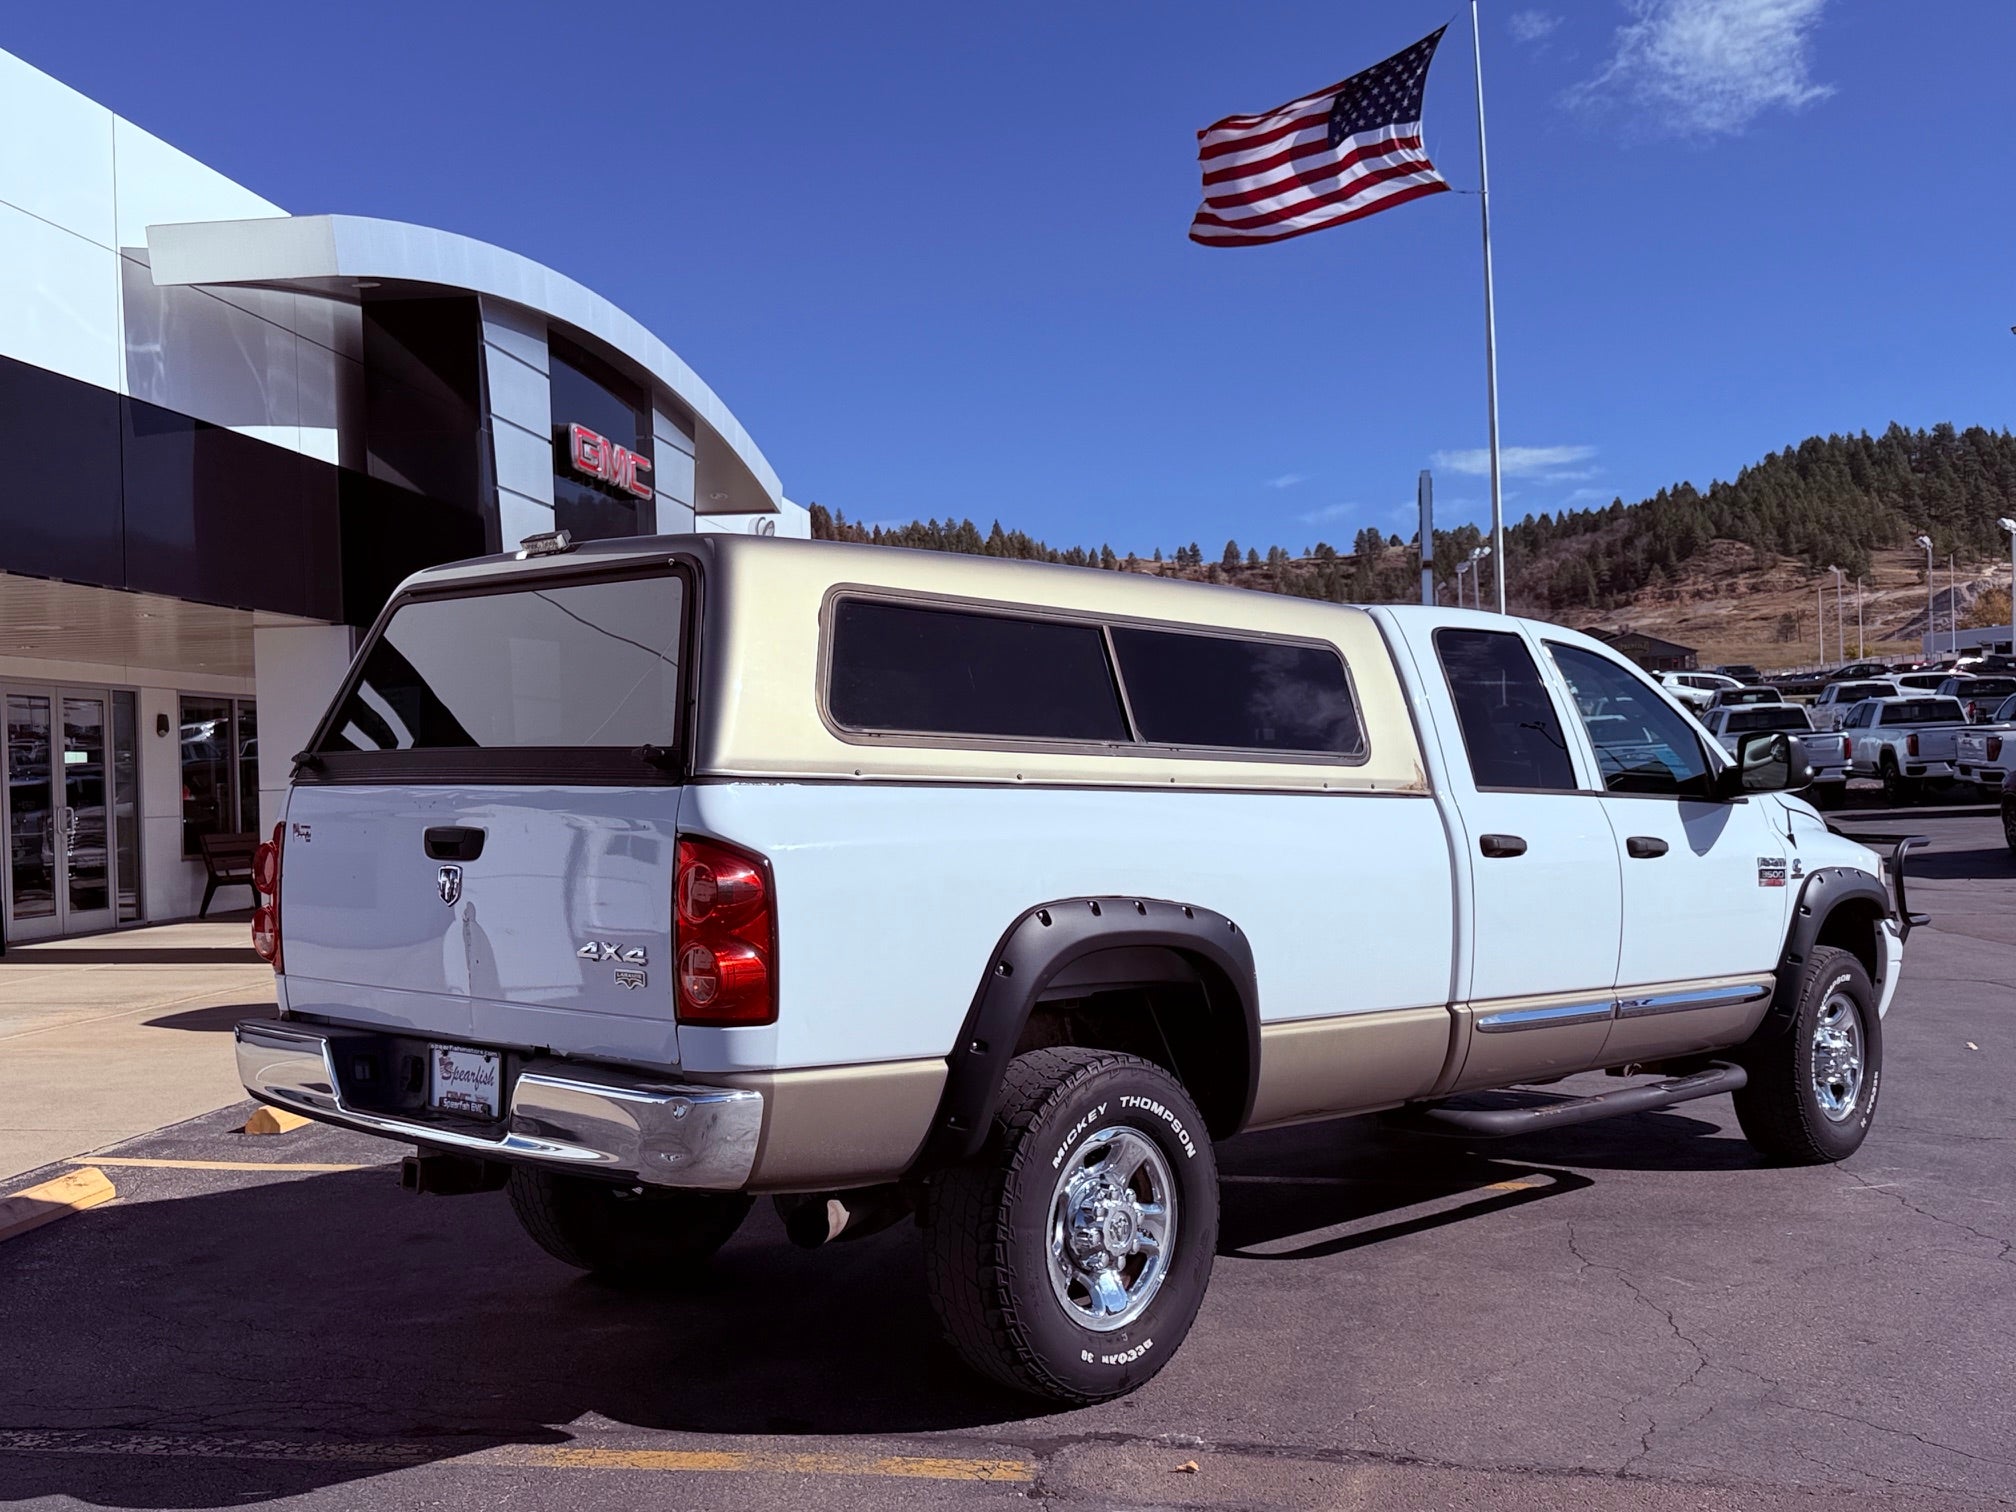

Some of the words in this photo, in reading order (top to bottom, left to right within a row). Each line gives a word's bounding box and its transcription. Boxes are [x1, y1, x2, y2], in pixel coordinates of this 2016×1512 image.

[568, 422, 653, 501] GMC
[1051, 1102, 1108, 1169] MICKEY
[1119, 1095, 1197, 1159] THOMPSON
